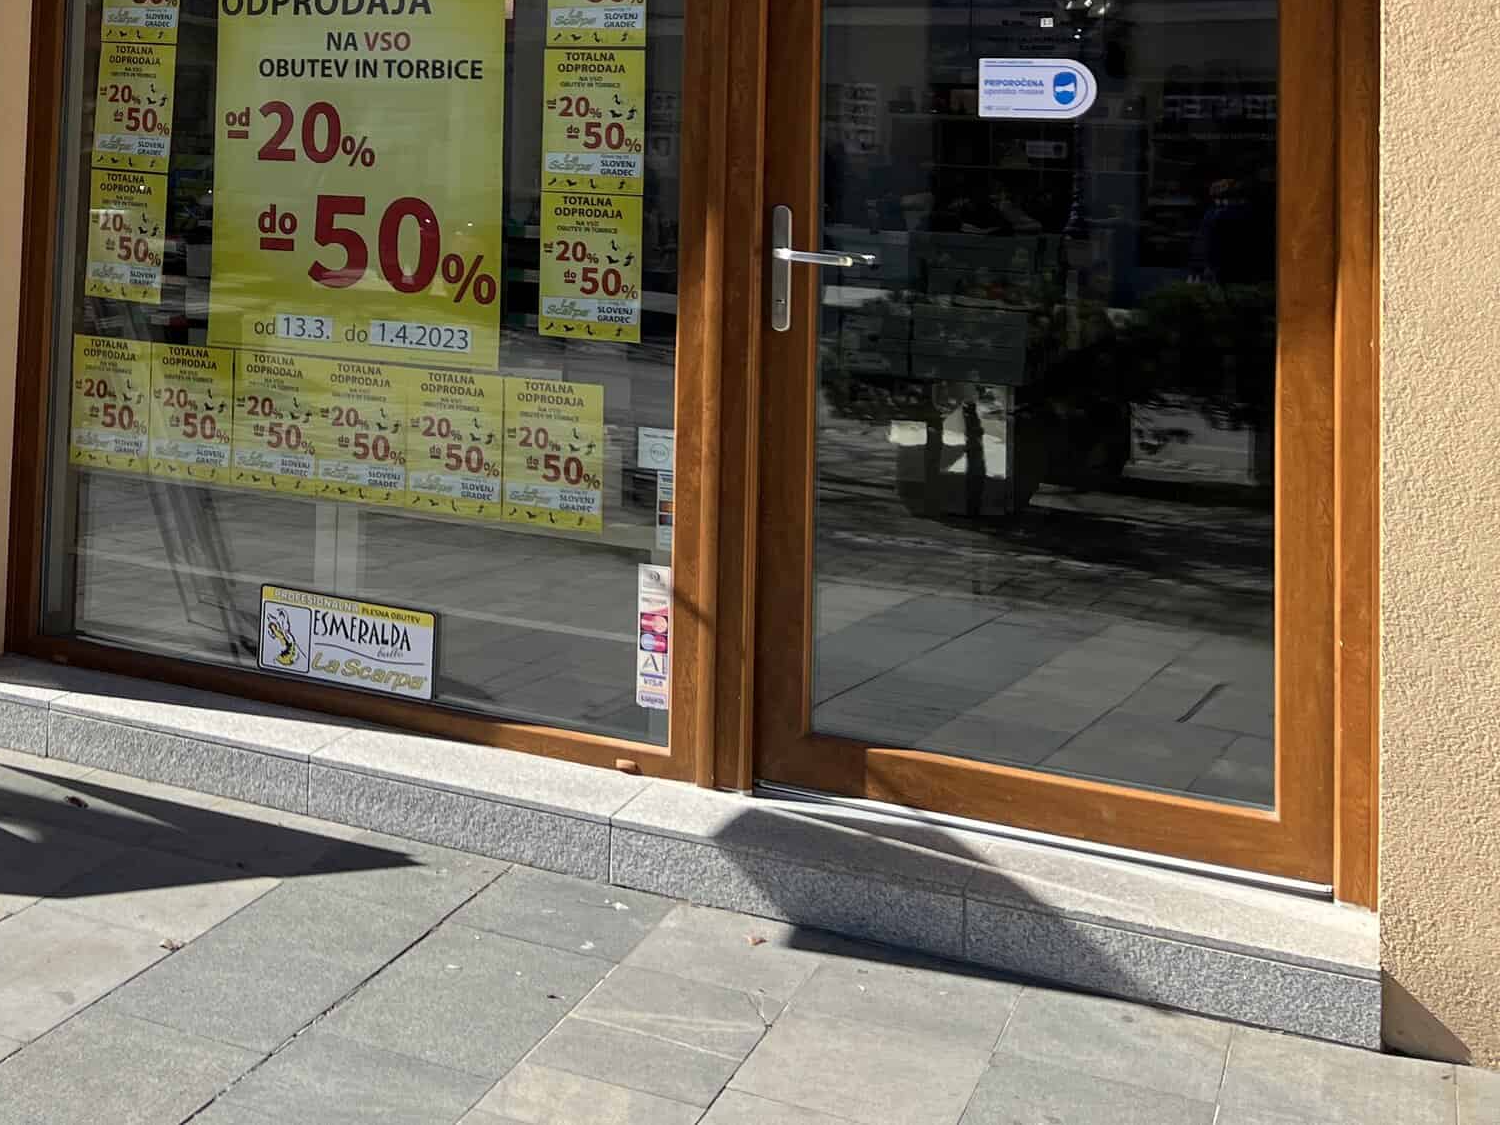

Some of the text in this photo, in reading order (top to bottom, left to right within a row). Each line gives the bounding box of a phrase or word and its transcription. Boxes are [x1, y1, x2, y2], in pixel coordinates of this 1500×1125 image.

[326, 31, 411, 52] NA VSO
[566, 52, 615, 61] TOTALNA
[258, 59, 484, 80] OBUTEV IN TORBICE
[558, 64, 626, 73] ODPRODAJA
[559, 96, 602, 118] 20%
[225, 100, 376, 168] od 20%
[583, 122, 641, 152] 50%
[600, 160, 636, 168] SLOVENJ
[563, 196, 612, 206] TOTALNA
[555, 207, 623, 219] ODPRODAJA
[258, 194, 498, 306] do 50%
[556, 240, 599, 263] 20%
[580, 267, 638, 299] 50%
[597, 306, 632, 314] SLOVENJ
[598, 315, 630, 323] GRADEC
[254, 317, 470, 350] od 13.3. do 1.4.2023
[428, 372, 475, 385] TOTALNA
[526, 382, 574, 394] TOTALNA
[421, 383, 484, 398] ODPRODAJA
[517, 392, 584, 406] ODPRODAJA
[422, 416, 462, 441] 20%
[518, 427, 560, 451] 20%
[445, 443, 500, 477] 50%
[542, 454, 600, 489] 50%
[313, 610, 411, 652] ESMERALDA
[312, 652, 424, 690] La Scarpa
